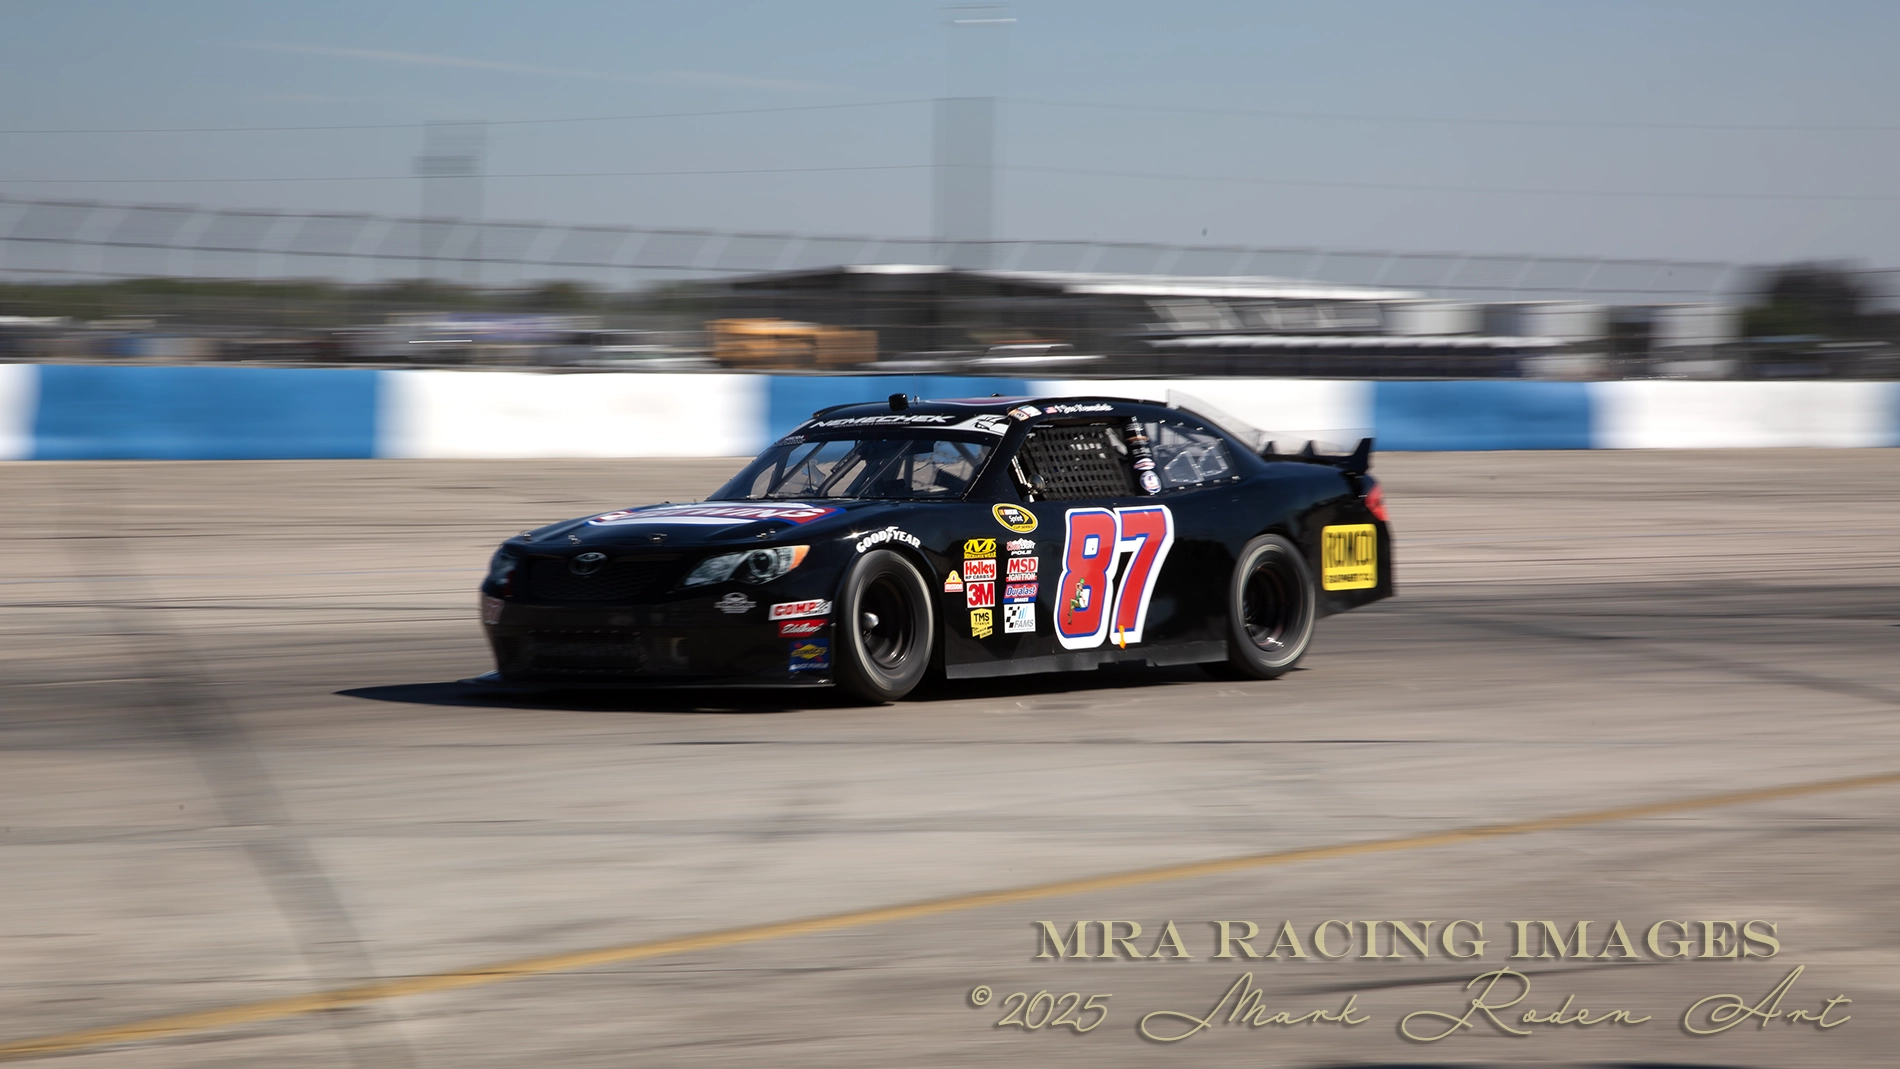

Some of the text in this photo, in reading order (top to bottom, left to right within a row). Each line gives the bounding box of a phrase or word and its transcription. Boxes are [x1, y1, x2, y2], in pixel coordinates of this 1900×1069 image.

[809, 415, 956, 429] NEMECHEK
[1008, 515, 1024, 523] Sprint
[856, 526, 921, 553] GOODYEAR
[965, 561, 995, 578] Holley
[1008, 558, 1037, 573] MSD
[1008, 573, 1036, 581] IGNITION
[1053, 504, 1175, 650] 87
[968, 583, 995, 606] 3M
[1006, 586, 1036, 596] Duralast
[774, 602, 816, 616] COMP
[974, 612, 990, 622] TMS
[1014, 619, 1034, 628] FAMS
